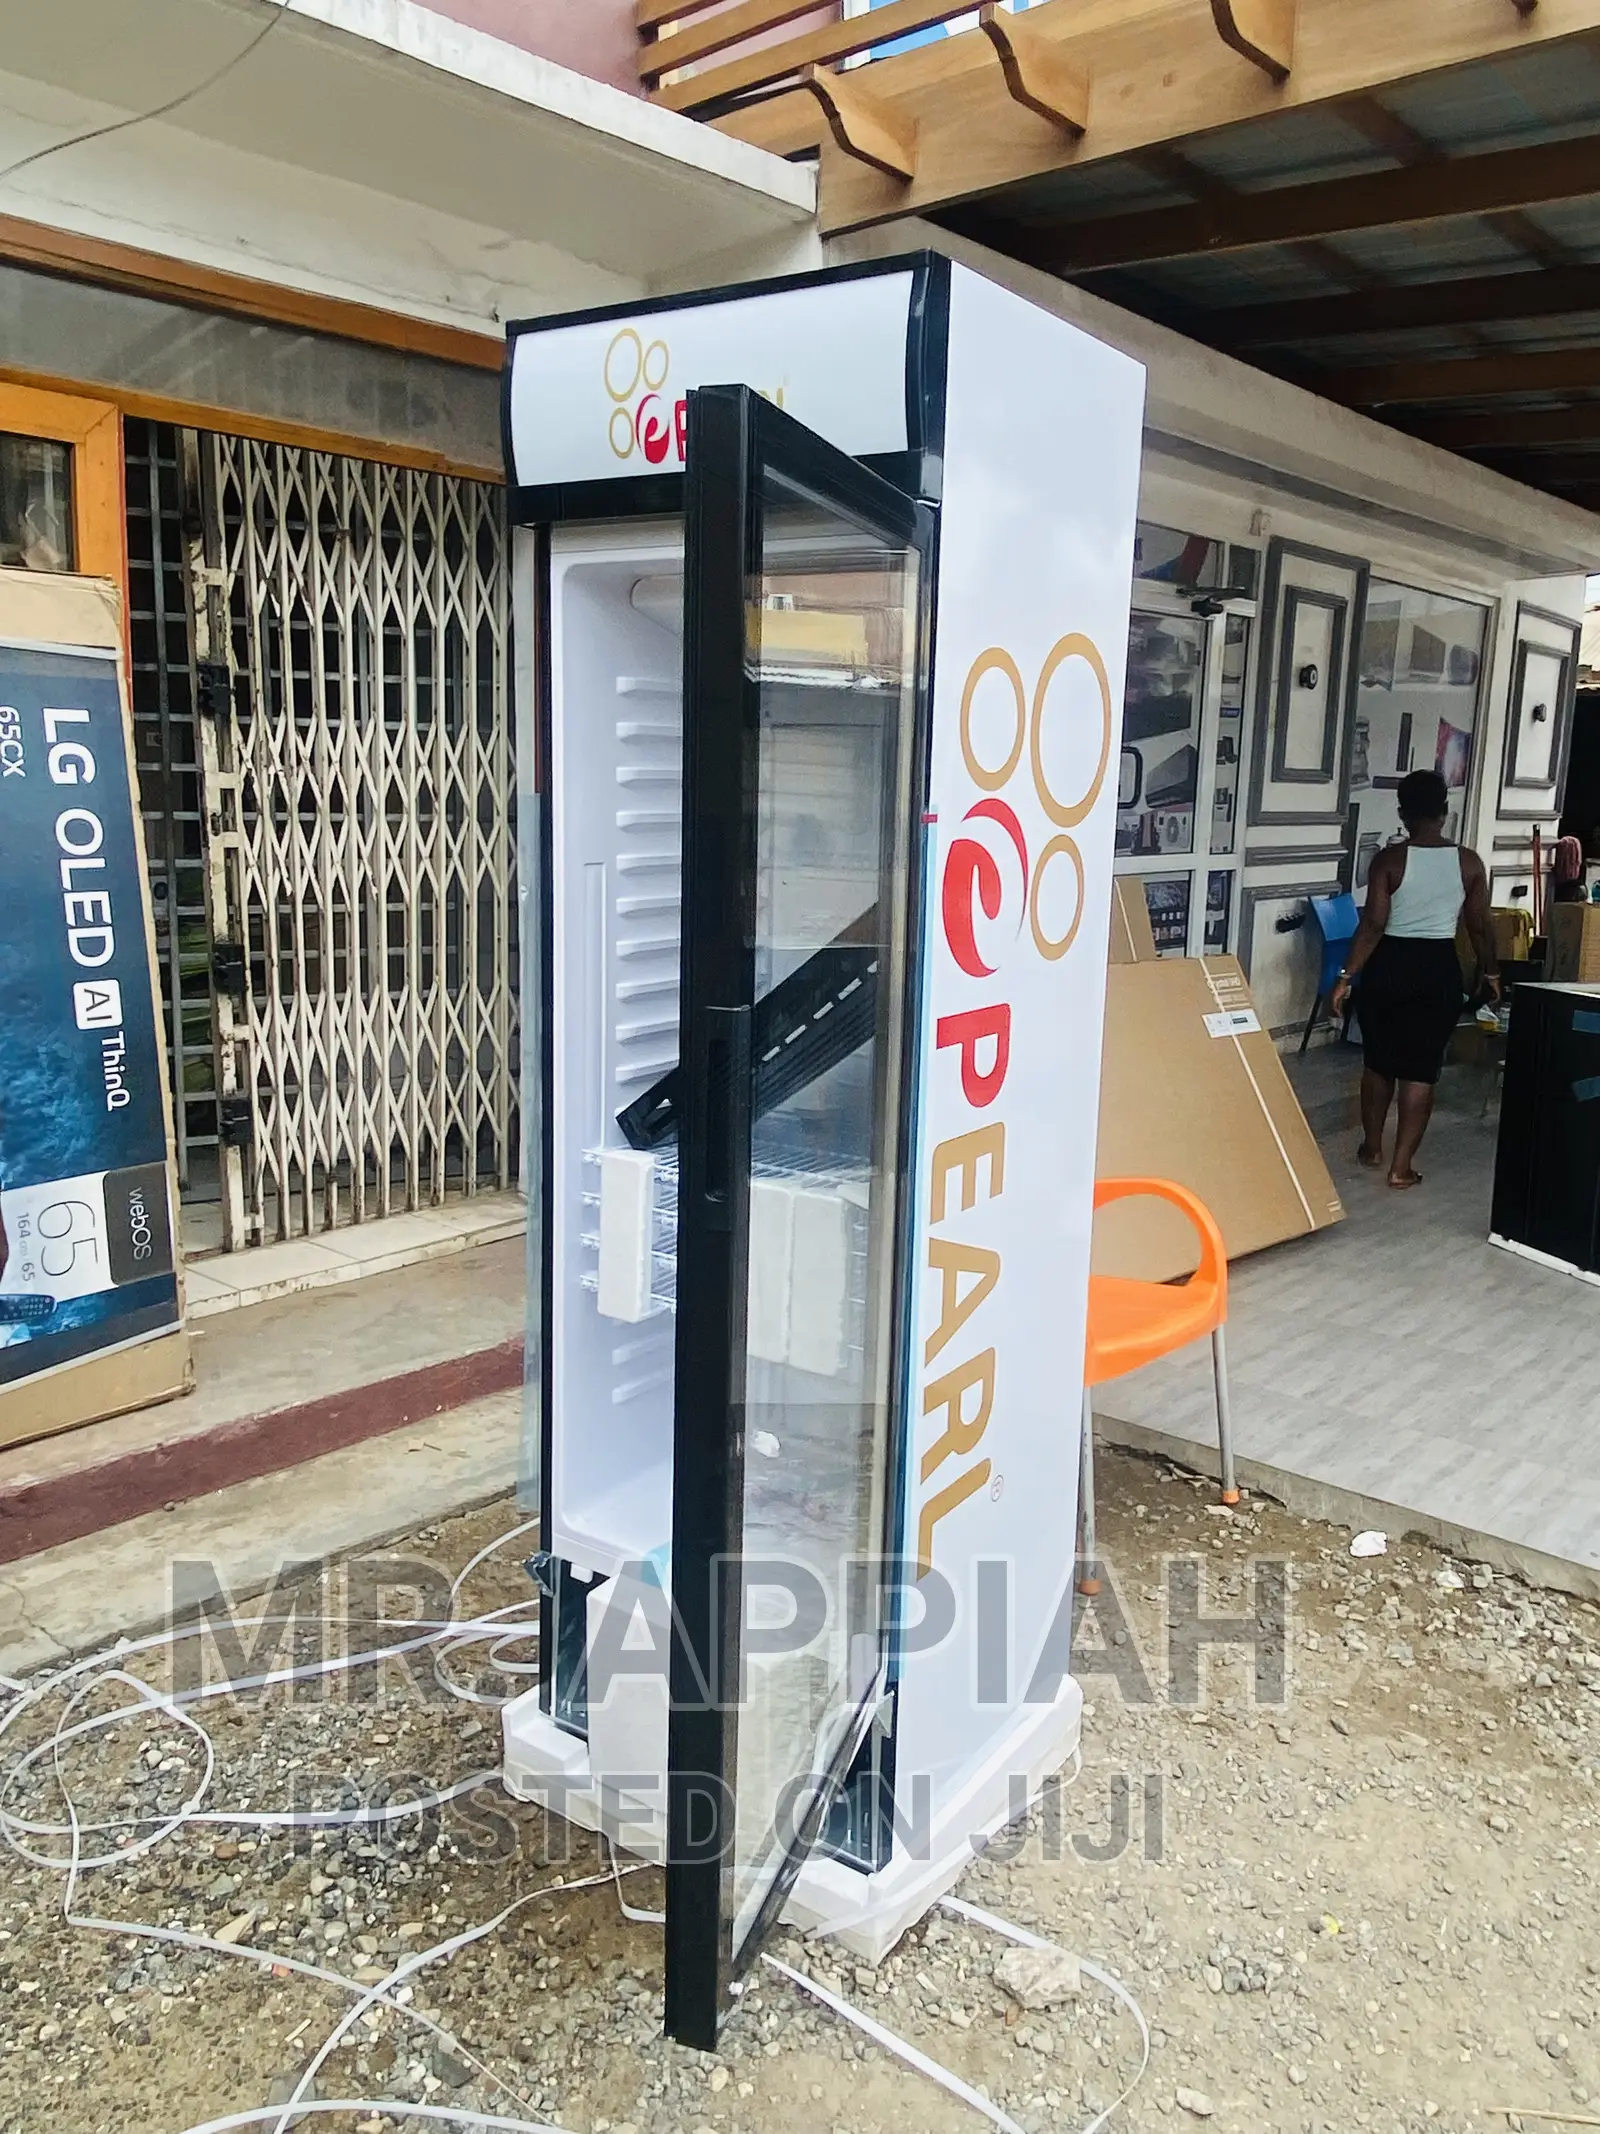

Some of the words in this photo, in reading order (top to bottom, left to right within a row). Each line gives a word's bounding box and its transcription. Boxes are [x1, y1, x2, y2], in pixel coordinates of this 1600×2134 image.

[0, 705, 26, 778] 65CX
[42, 707, 97, 785] LG
[54, 807, 116, 969] OLED
[83, 987, 114, 1022] AI
[99, 1031, 131, 1111] ThinQ
[16, 1212, 32, 1239] 164
[37, 1200, 98, 1276] 65
[128, 1186, 153, 1261] webOS
[20, 1262, 35, 1282] 65
[916, 1002, 1011, 1581] PEARL
